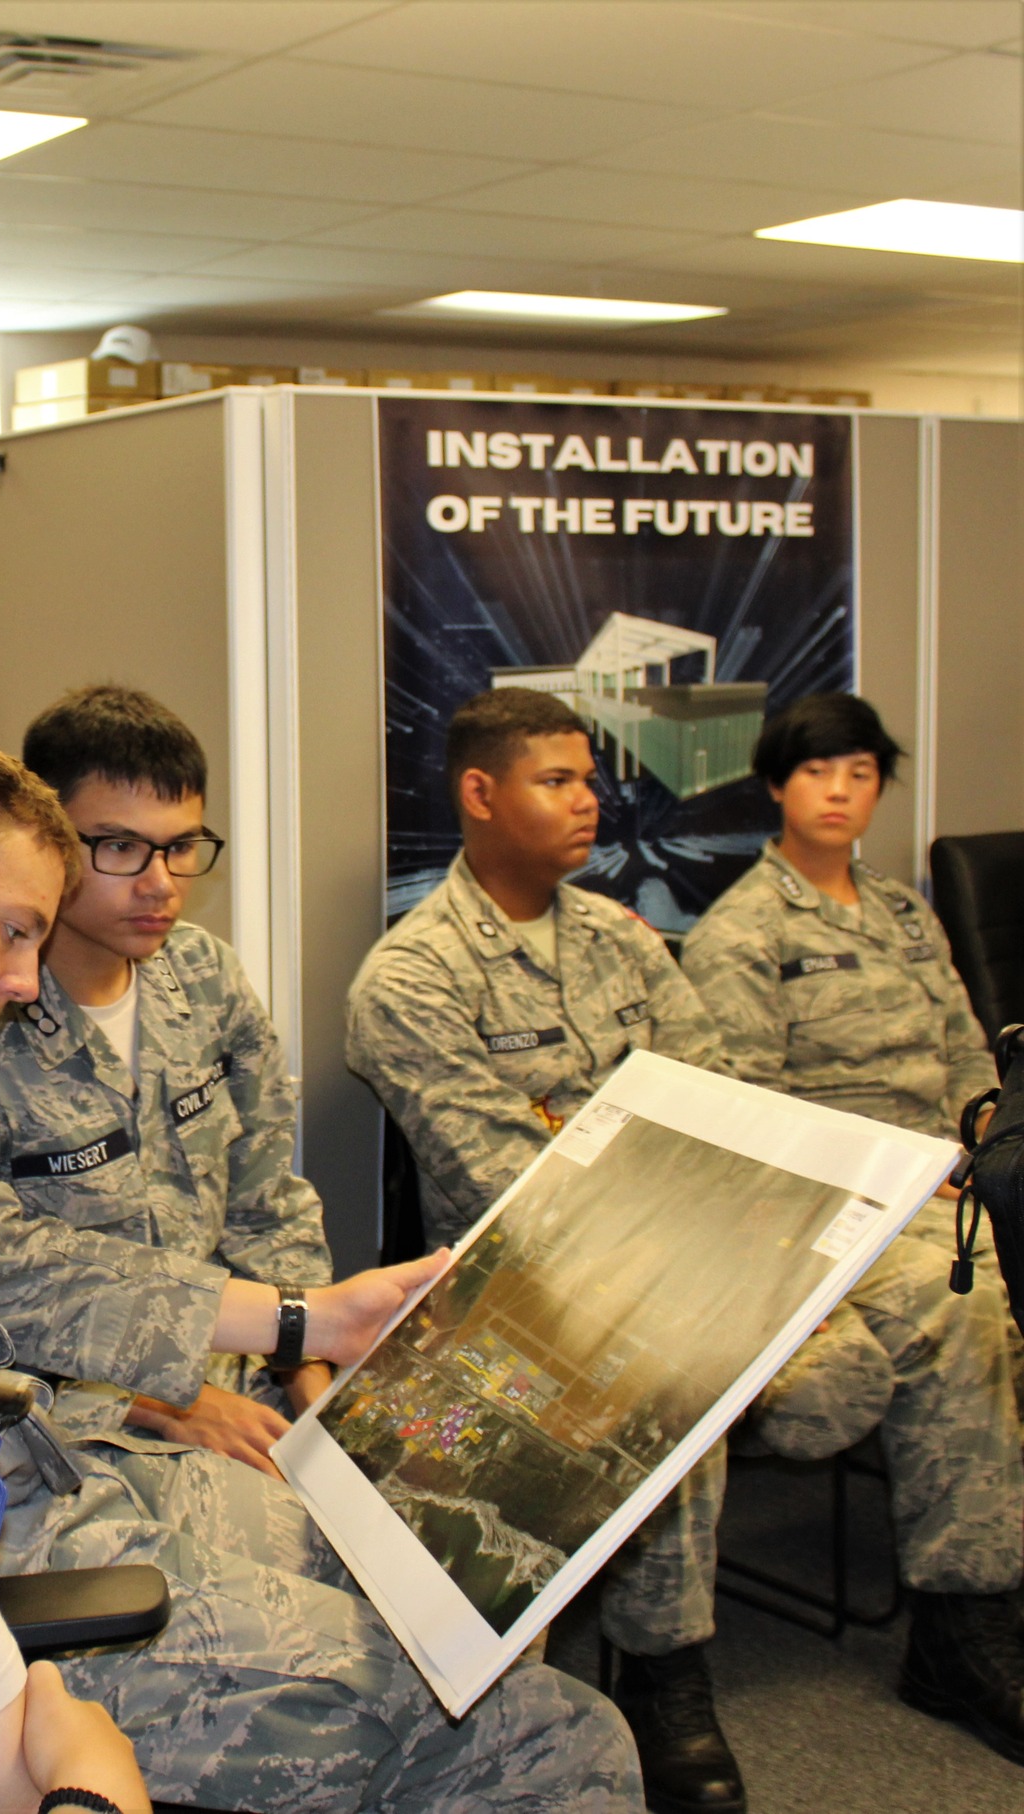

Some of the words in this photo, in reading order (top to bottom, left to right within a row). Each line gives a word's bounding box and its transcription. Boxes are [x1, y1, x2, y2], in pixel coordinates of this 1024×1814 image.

[427, 430, 814, 478] INSTALLATION
[426, 495, 502, 533] OF
[510, 496, 616, 535] THE
[623, 499, 815, 537] FUTURE
[47, 1141, 108, 1174] WIESERT
